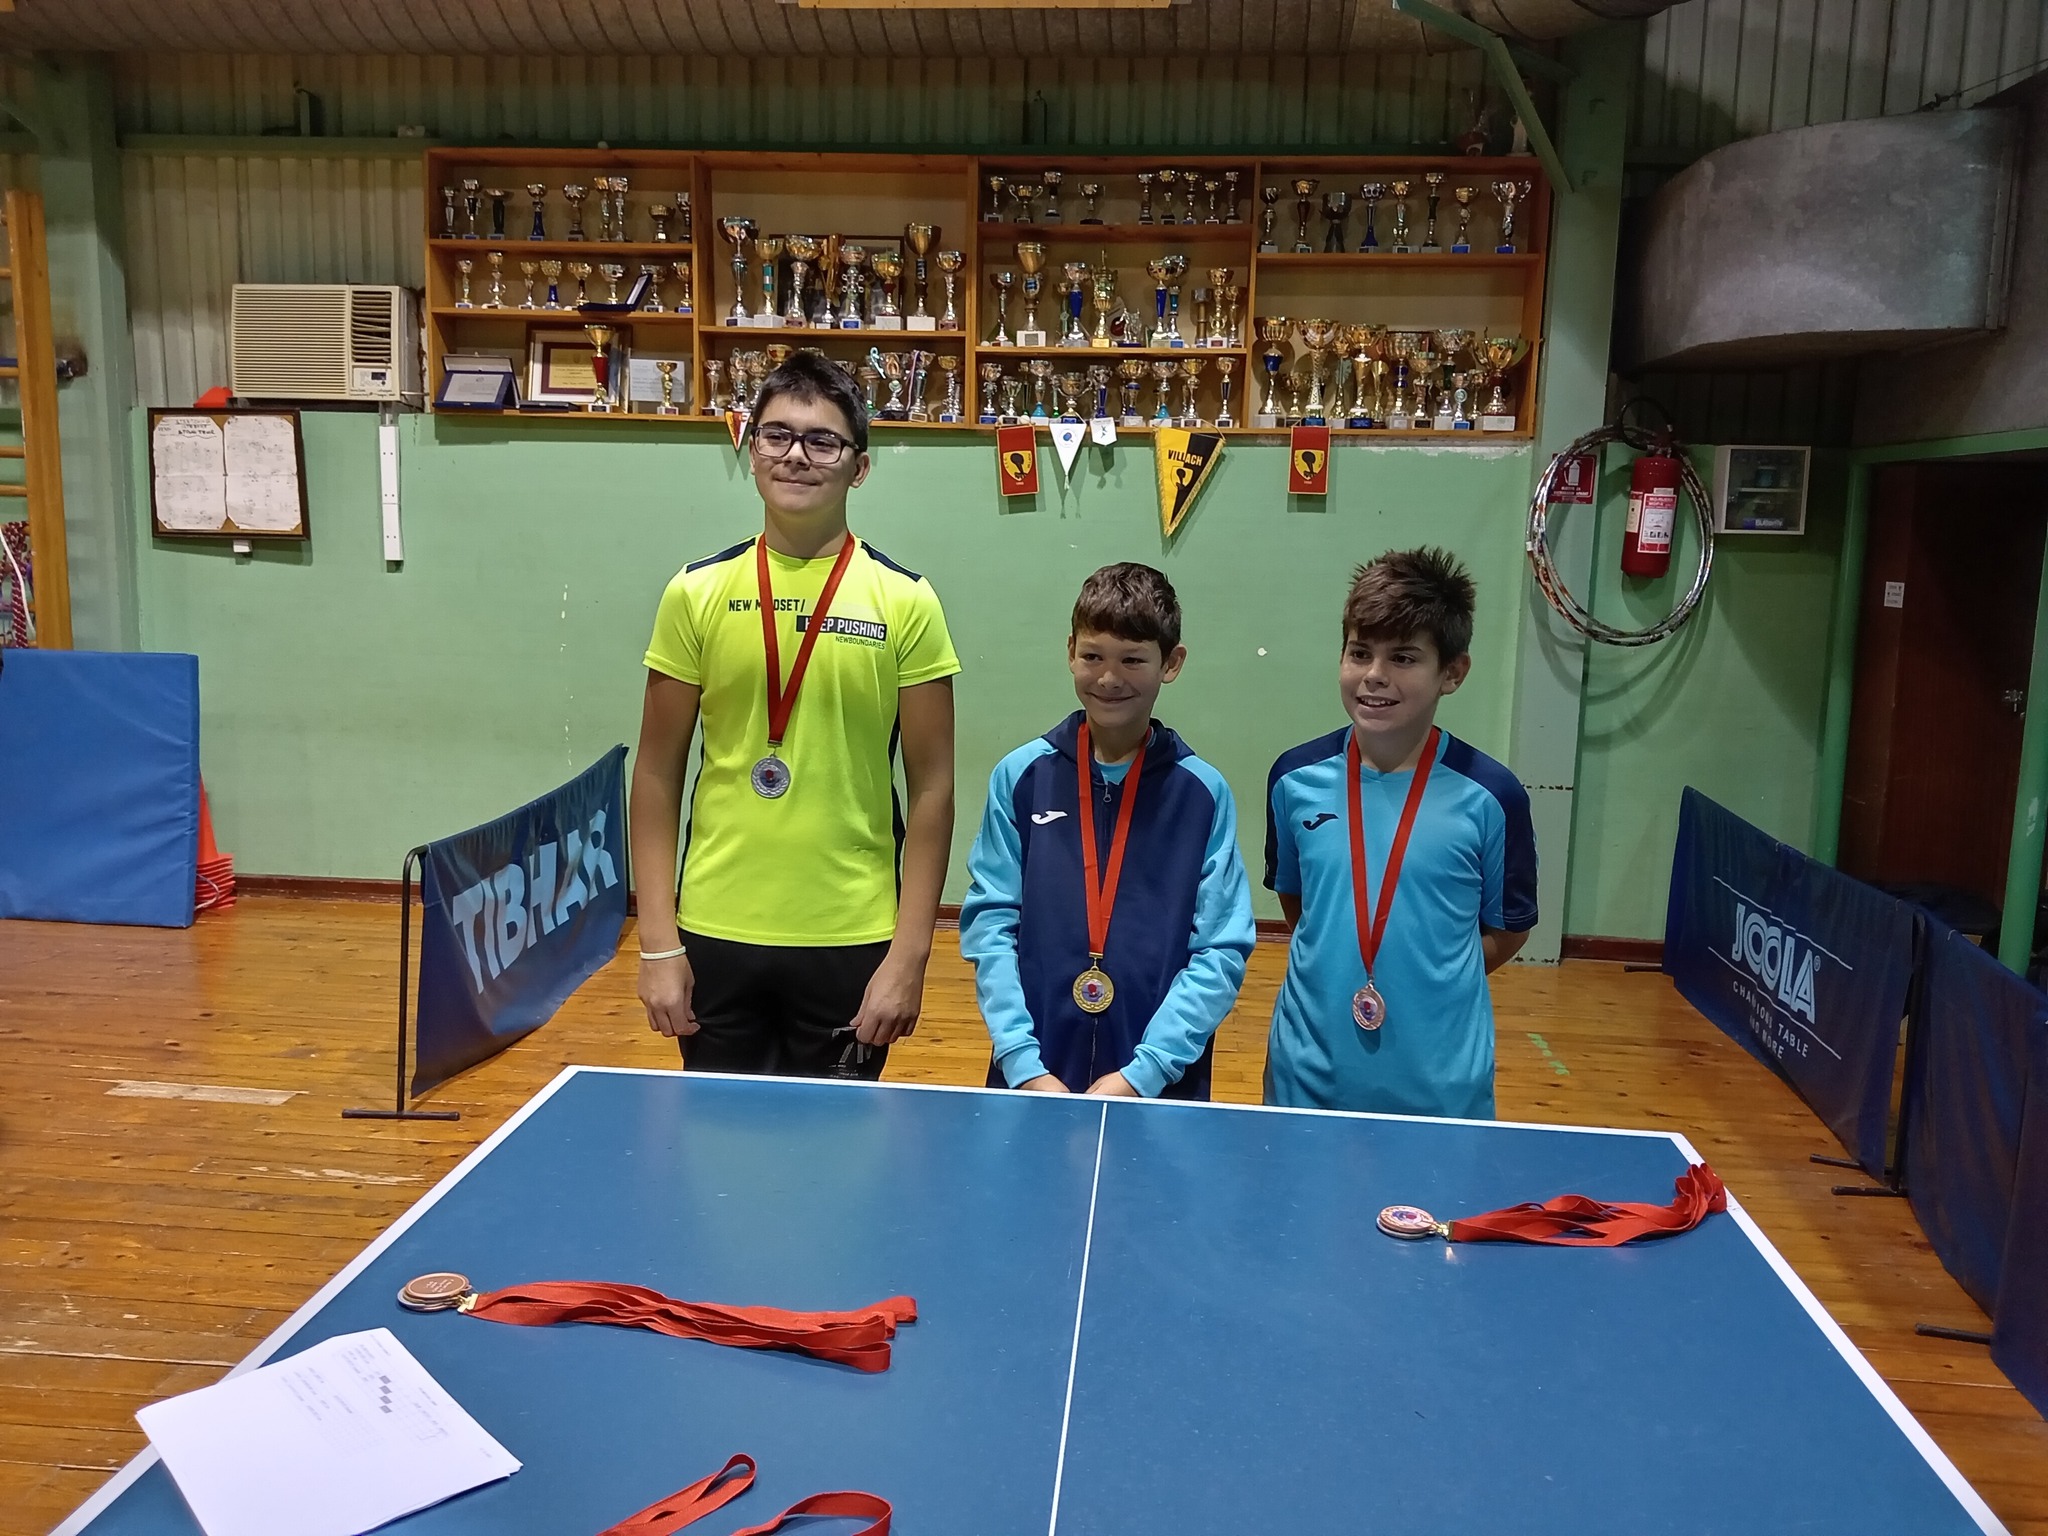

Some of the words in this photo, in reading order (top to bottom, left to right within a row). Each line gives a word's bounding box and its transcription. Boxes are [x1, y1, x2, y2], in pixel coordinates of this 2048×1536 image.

[1168, 449, 1203, 466] VILLACH
[728, 599, 752, 612] NEW
[755, 598, 806, 613] MDSET/
[804, 616, 834, 632] KEP
[837, 618, 885, 640] PUSHING
[453, 809, 618, 994] TIBHAR
[1762, 1028, 1785, 1059] MORE
[1777, 1022, 1809, 1058] TABLE
